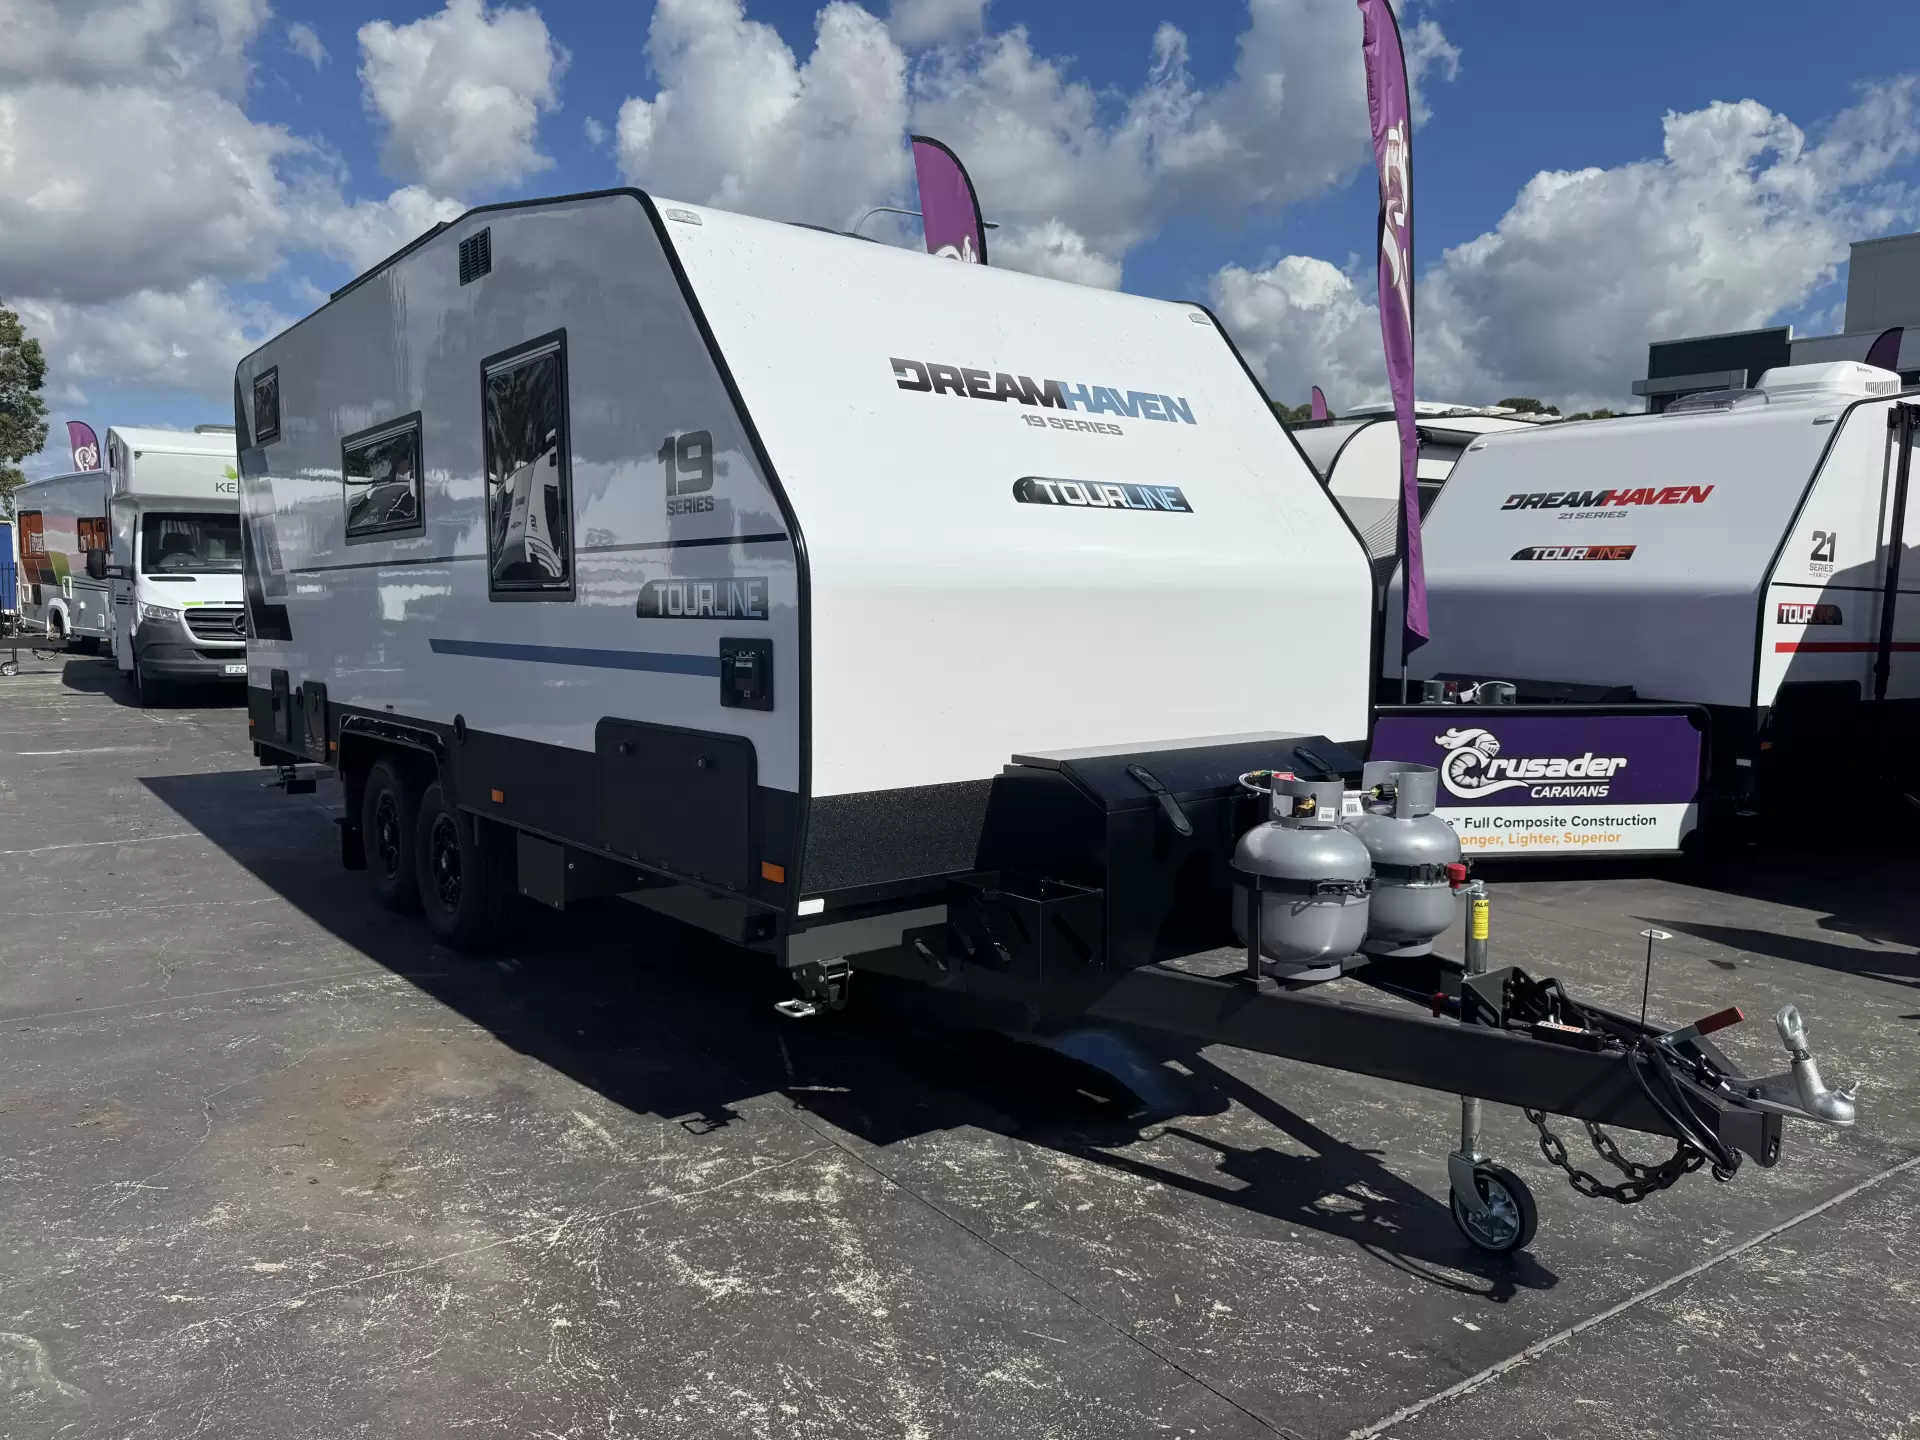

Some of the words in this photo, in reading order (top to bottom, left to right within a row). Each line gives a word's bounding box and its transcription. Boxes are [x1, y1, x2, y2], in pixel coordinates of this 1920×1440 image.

[889, 357, 1197, 425] DREAMHAVEN
[1021, 414, 1046, 427] 19
[1047, 417, 1123, 435] SERIES
[658, 430, 714, 496] 19
[216, 482, 239, 493] KE
[1032, 478, 1186, 511] TOURLINE
[1500, 485, 1715, 510] DREAMHAVEN
[666, 496, 714, 516] SERIES
[1575, 511, 1628, 519] SERIES
[1531, 546, 1630, 560] TOURLINE
[1811, 531, 1836, 562] 21
[1810, 563, 1833, 572] SERIES
[653, 581, 763, 617] TOURLINE
[1441, 746, 1627, 799] Crusader
[1531, 785, 1609, 798] CARAVANS
[1464, 817, 1489, 829] Full
[1493, 816, 1567, 830] Composite
[1571, 814, 1656, 827] Construction
[1460, 834, 1504, 847] onger,
[1508, 833, 1559, 847] Lighter,
[1563, 832, 1621, 845] Superior
